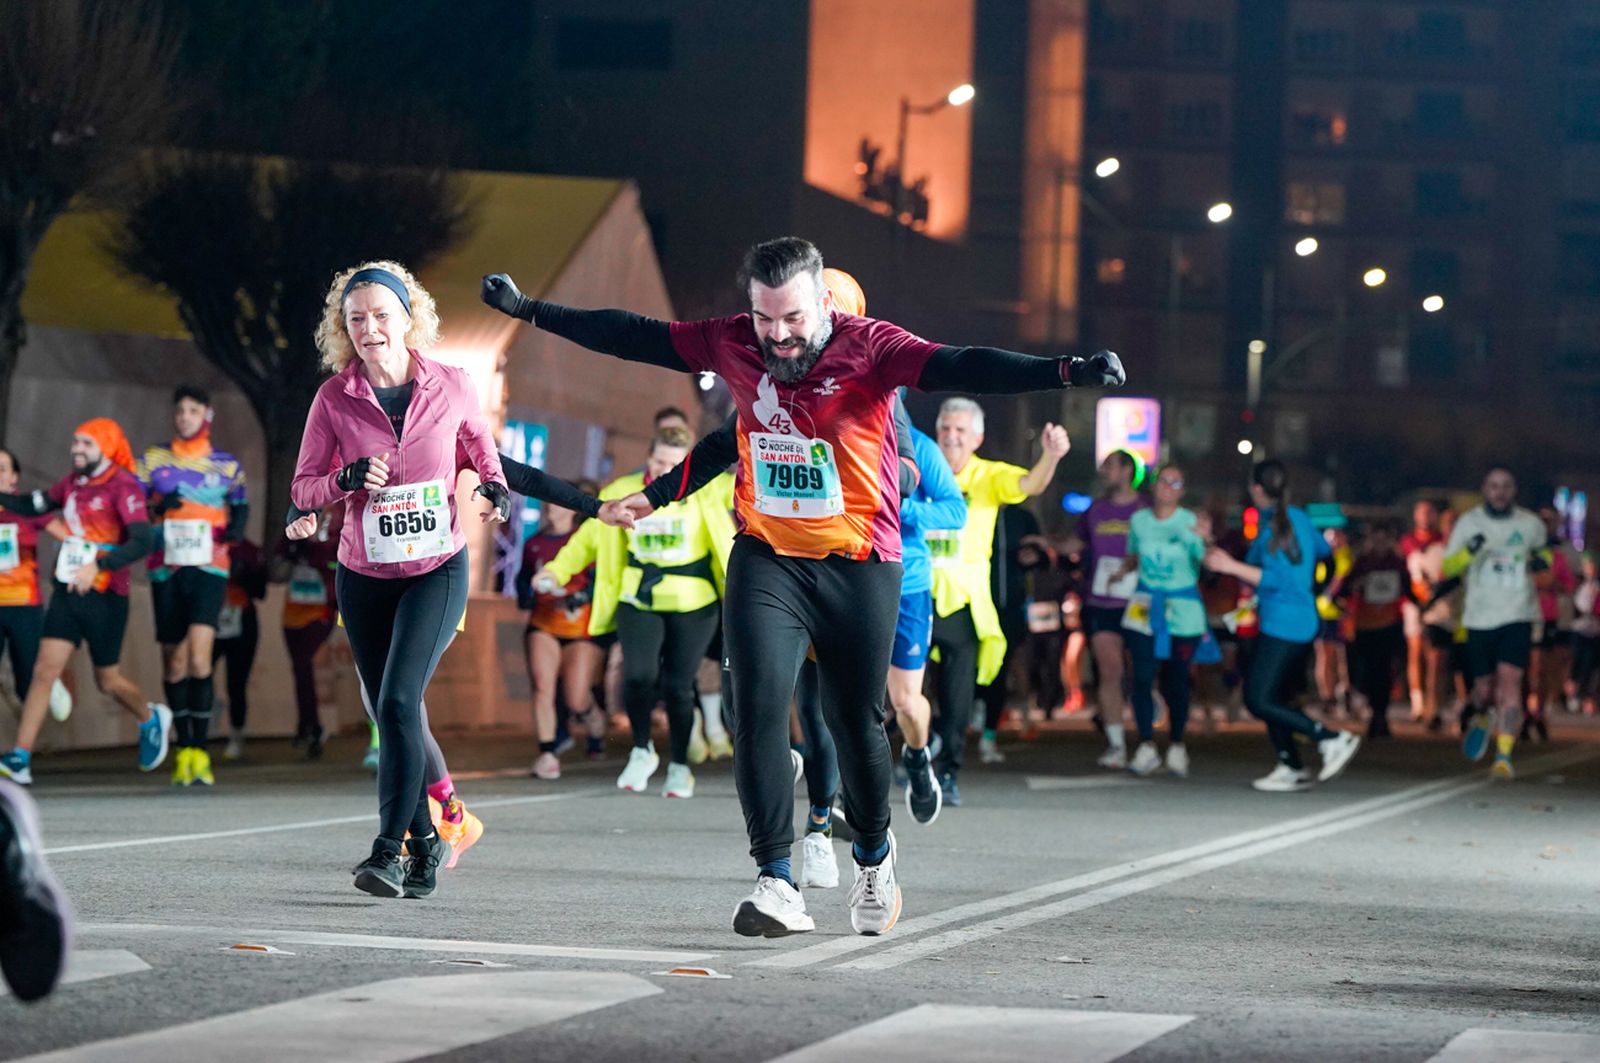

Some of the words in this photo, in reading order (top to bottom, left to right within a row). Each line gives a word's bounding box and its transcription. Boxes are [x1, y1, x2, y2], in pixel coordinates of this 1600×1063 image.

[768, 413, 792, 435] 43
[769, 443, 794, 453] NOCHE
[796, 446, 805, 454] DE
[760, 452, 776, 462] SAN
[766, 464, 823, 490] 7969
[381, 492, 405, 503] NOCHE
[407, 491, 416, 500] DE
[371, 505, 388, 514] SAN
[379, 509, 436, 537] 6656
